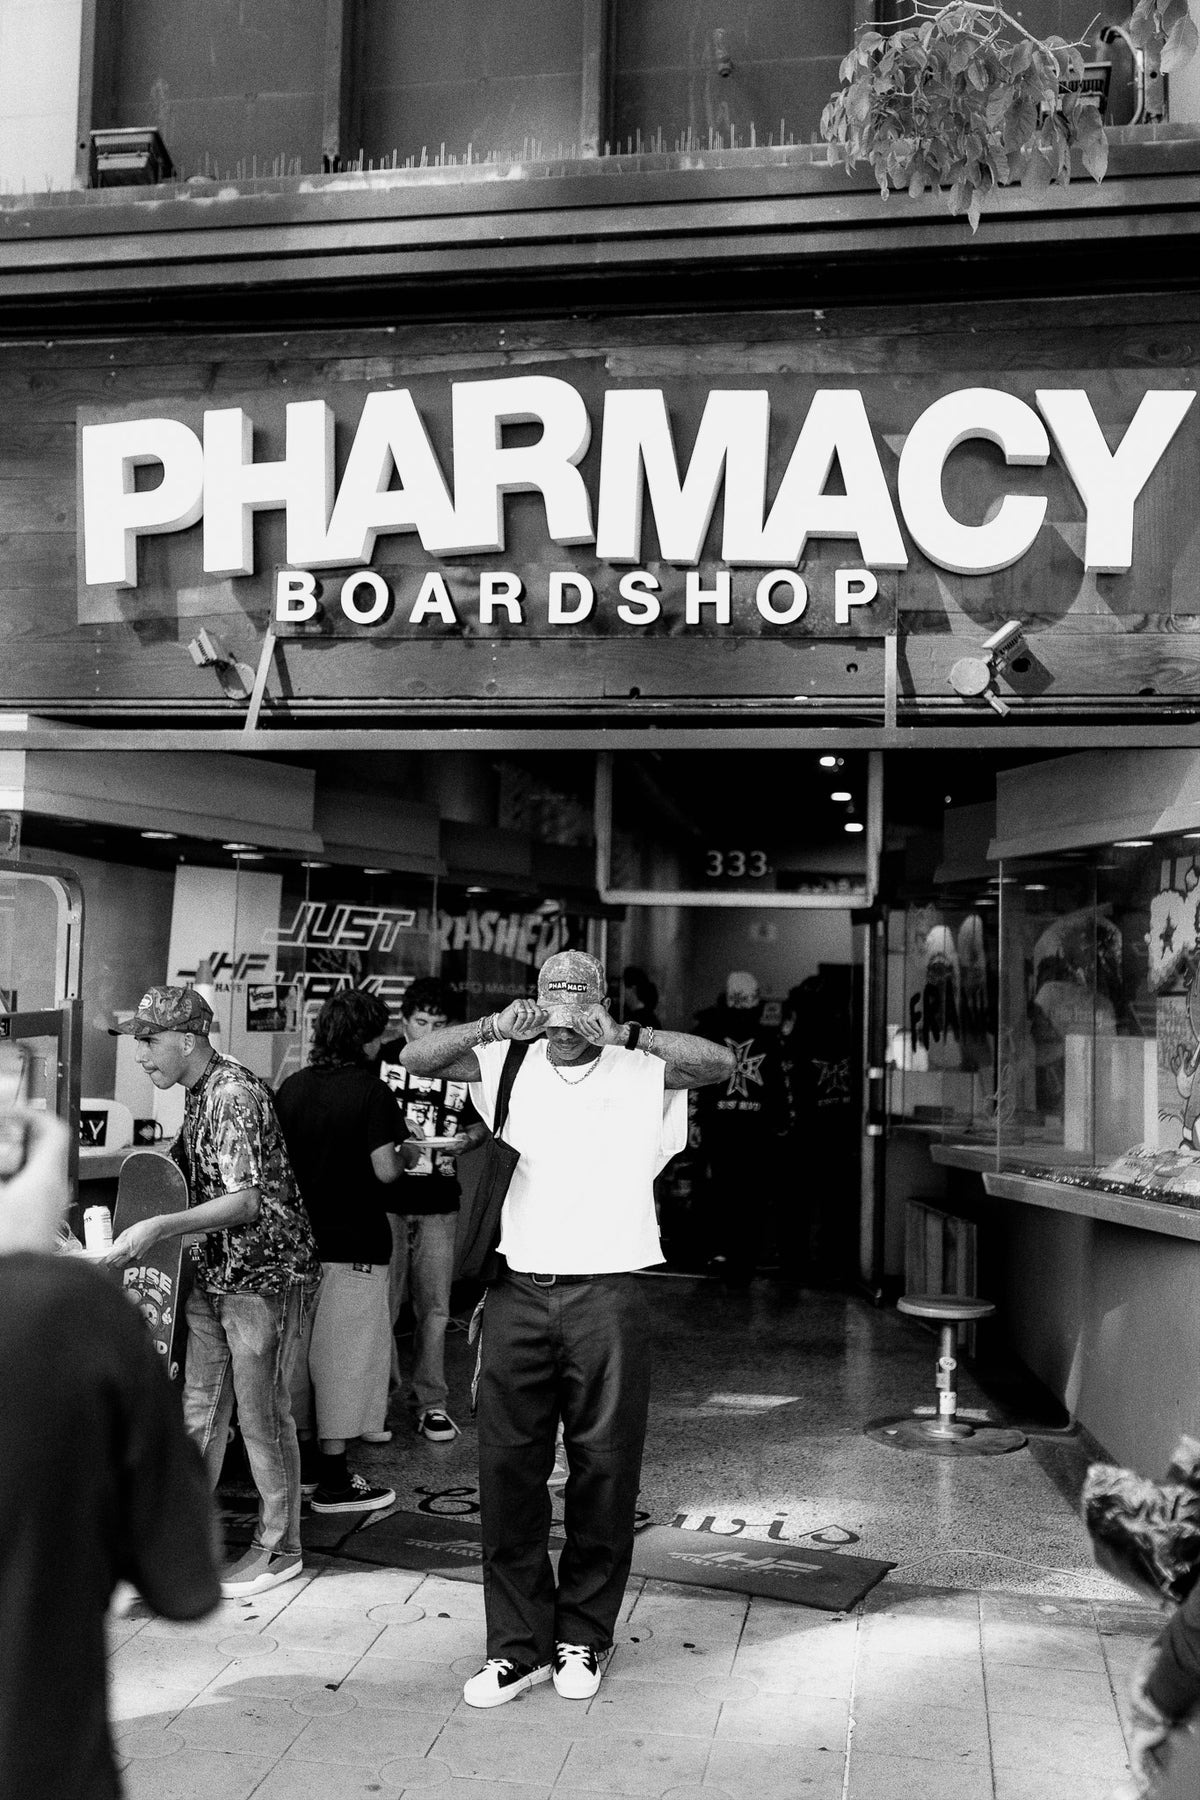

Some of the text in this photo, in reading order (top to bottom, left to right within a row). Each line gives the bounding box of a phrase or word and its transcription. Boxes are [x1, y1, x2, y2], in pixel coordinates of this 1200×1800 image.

[81, 375, 1197, 589] PHARMACY
[275, 568, 879, 626] BOARDSHOP
[706, 850, 767, 877] 333
[260, 902, 416, 952] JUST
[548, 981, 588, 992] PHARMACY
[123, 1266, 172, 1295] RISE
